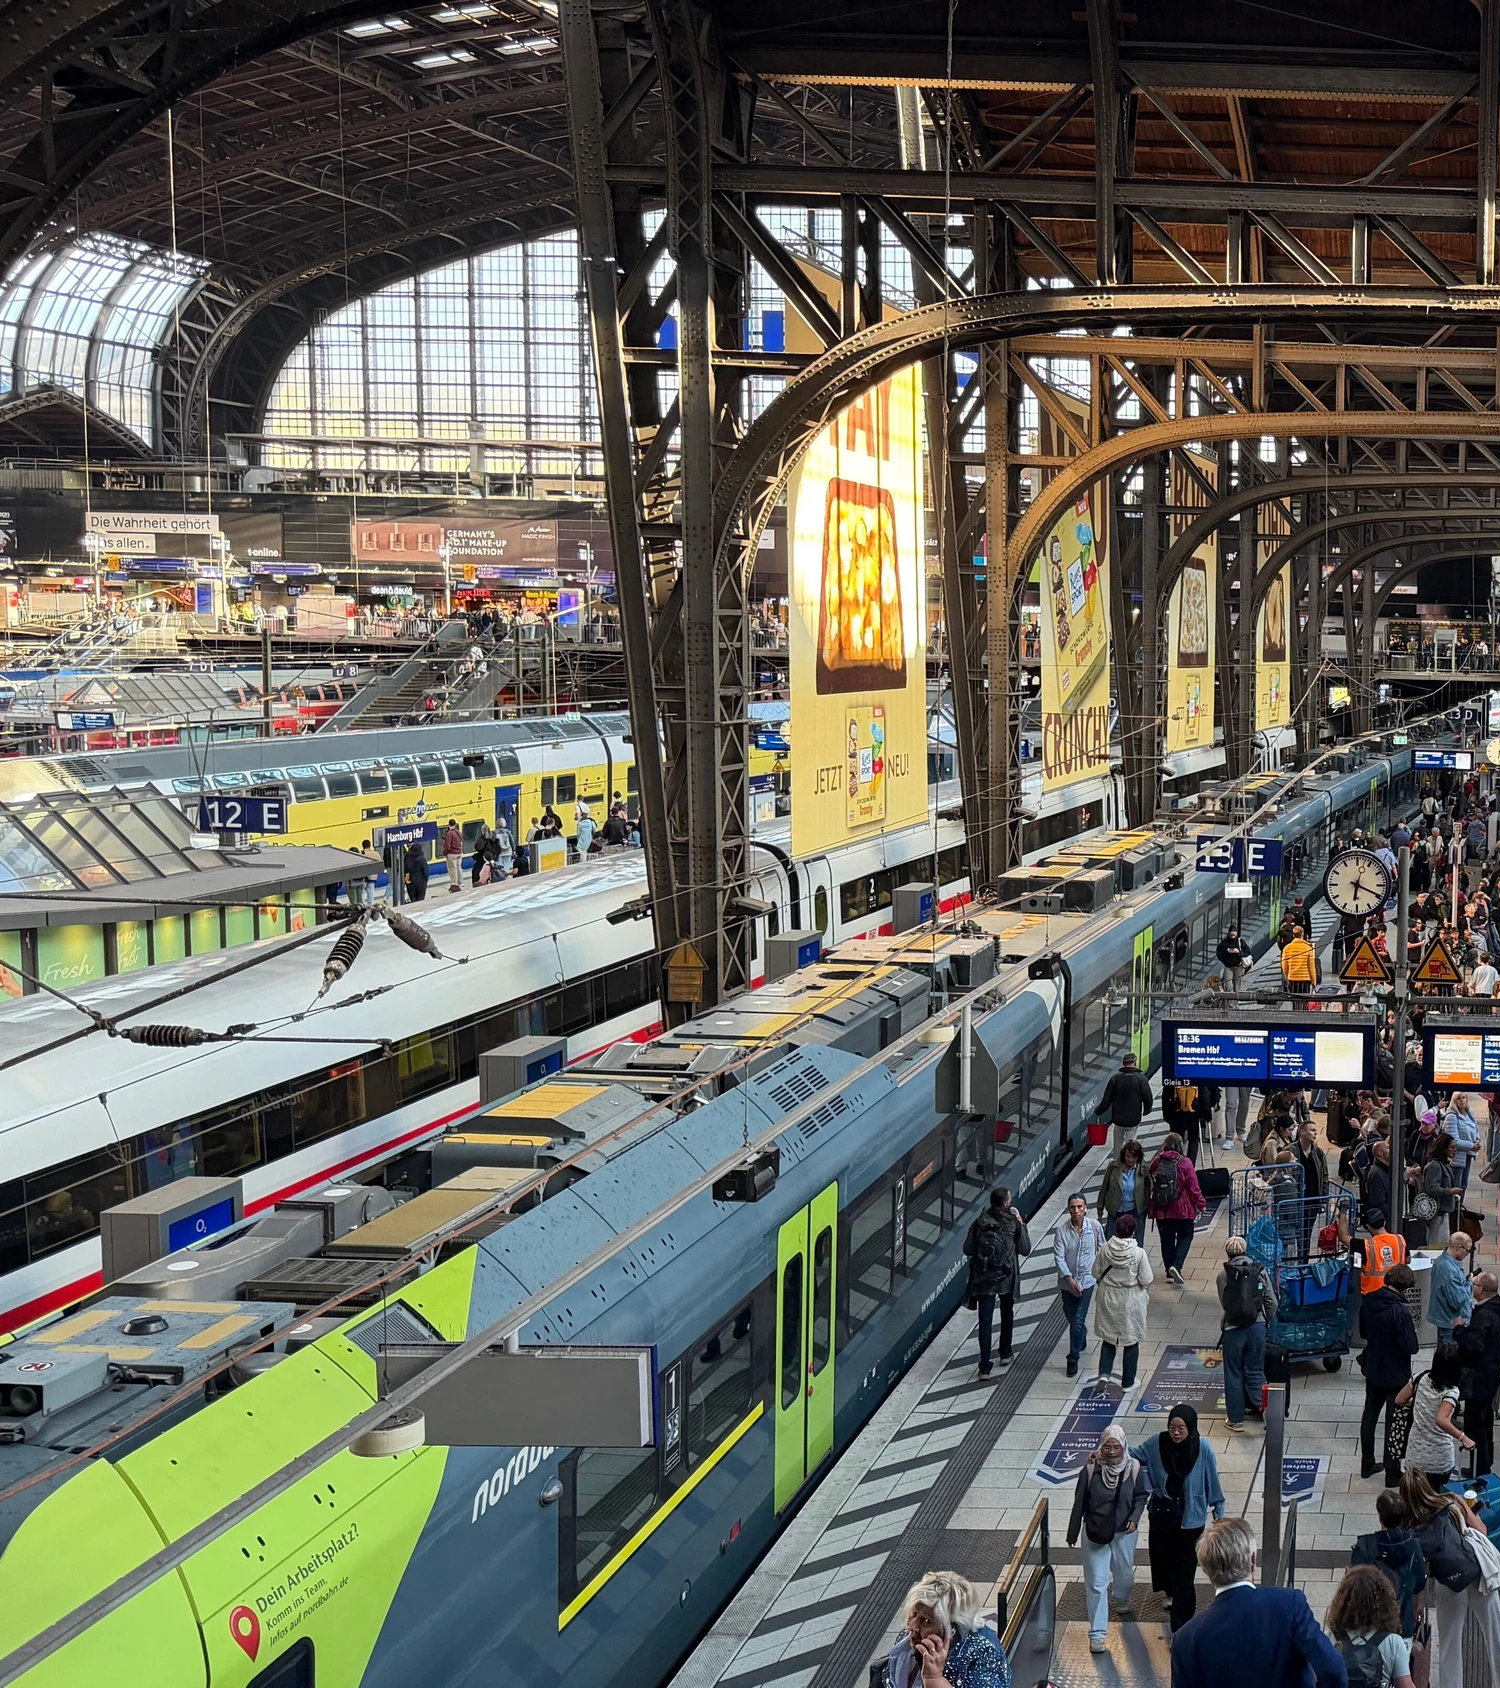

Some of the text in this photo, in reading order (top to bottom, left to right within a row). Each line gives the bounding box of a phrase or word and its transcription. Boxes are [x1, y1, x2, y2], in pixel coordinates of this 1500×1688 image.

[91, 516, 211, 532] Die Wahrheit gehört
[447, 530, 495, 538] GERMANY'S
[116, 538, 150, 549] allen.
[469, 540, 507, 548] MAKE-UP
[349, 666, 357, 677] 8
[1464, 710, 1473, 720] D
[1043, 705, 1110, 780] CRUNCHY
[814, 753, 909, 795] JETZT NEU!
[207, 801, 281, 830] 12 E
[387, 827, 424, 844] Hamburg Hbf
[1200, 840, 1266, 871] 13 E
[868, 878, 875, 894] 2
[117, 926, 141, 948] Fresh
[43, 953, 96, 983] Fresh
[117, 948, 141, 968] Fast
[1178, 1034, 1200, 1044] 18:36
[1178, 1045, 1220, 1055] Bremen Hbf
[1164, 1078, 1182, 1086] Gleis
[897, 1180, 904, 1210] 2
[668, 1369, 677, 1409] 1
[255, 1522, 359, 1614] Dein Arbeitsplatz?
[265, 1577, 328, 1631] Komm ins Team.
[269, 1575, 349, 1648] Infos auf nordbahn.de
